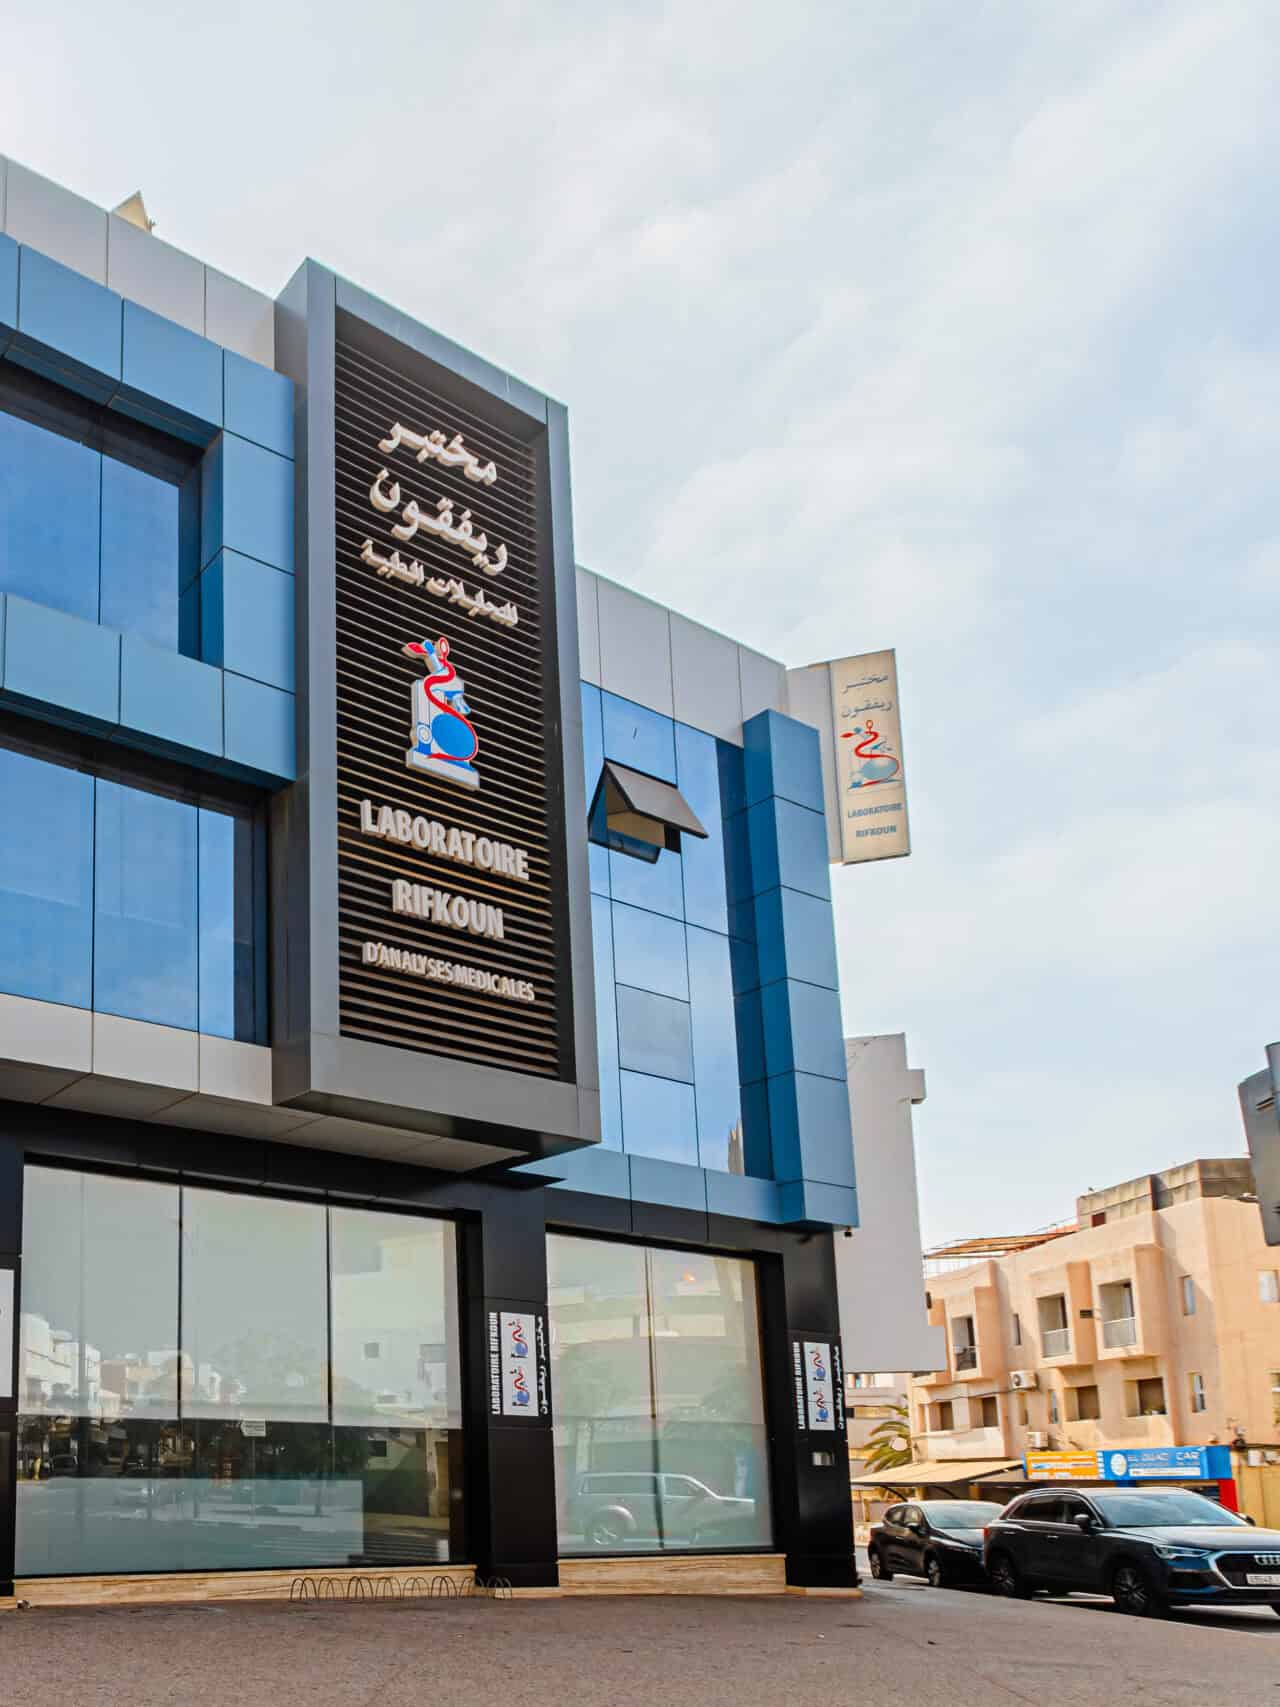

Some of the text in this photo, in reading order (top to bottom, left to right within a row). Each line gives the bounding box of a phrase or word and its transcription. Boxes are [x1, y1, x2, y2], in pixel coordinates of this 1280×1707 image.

[378, 422, 497, 486] مختبر
[370, 467, 508, 576] ريفقون
[360, 799, 529, 881] LABORATOIRE
[392, 879, 504, 939] RIFKOUN
[490, 1353, 501, 1415] LABORATOIRE
